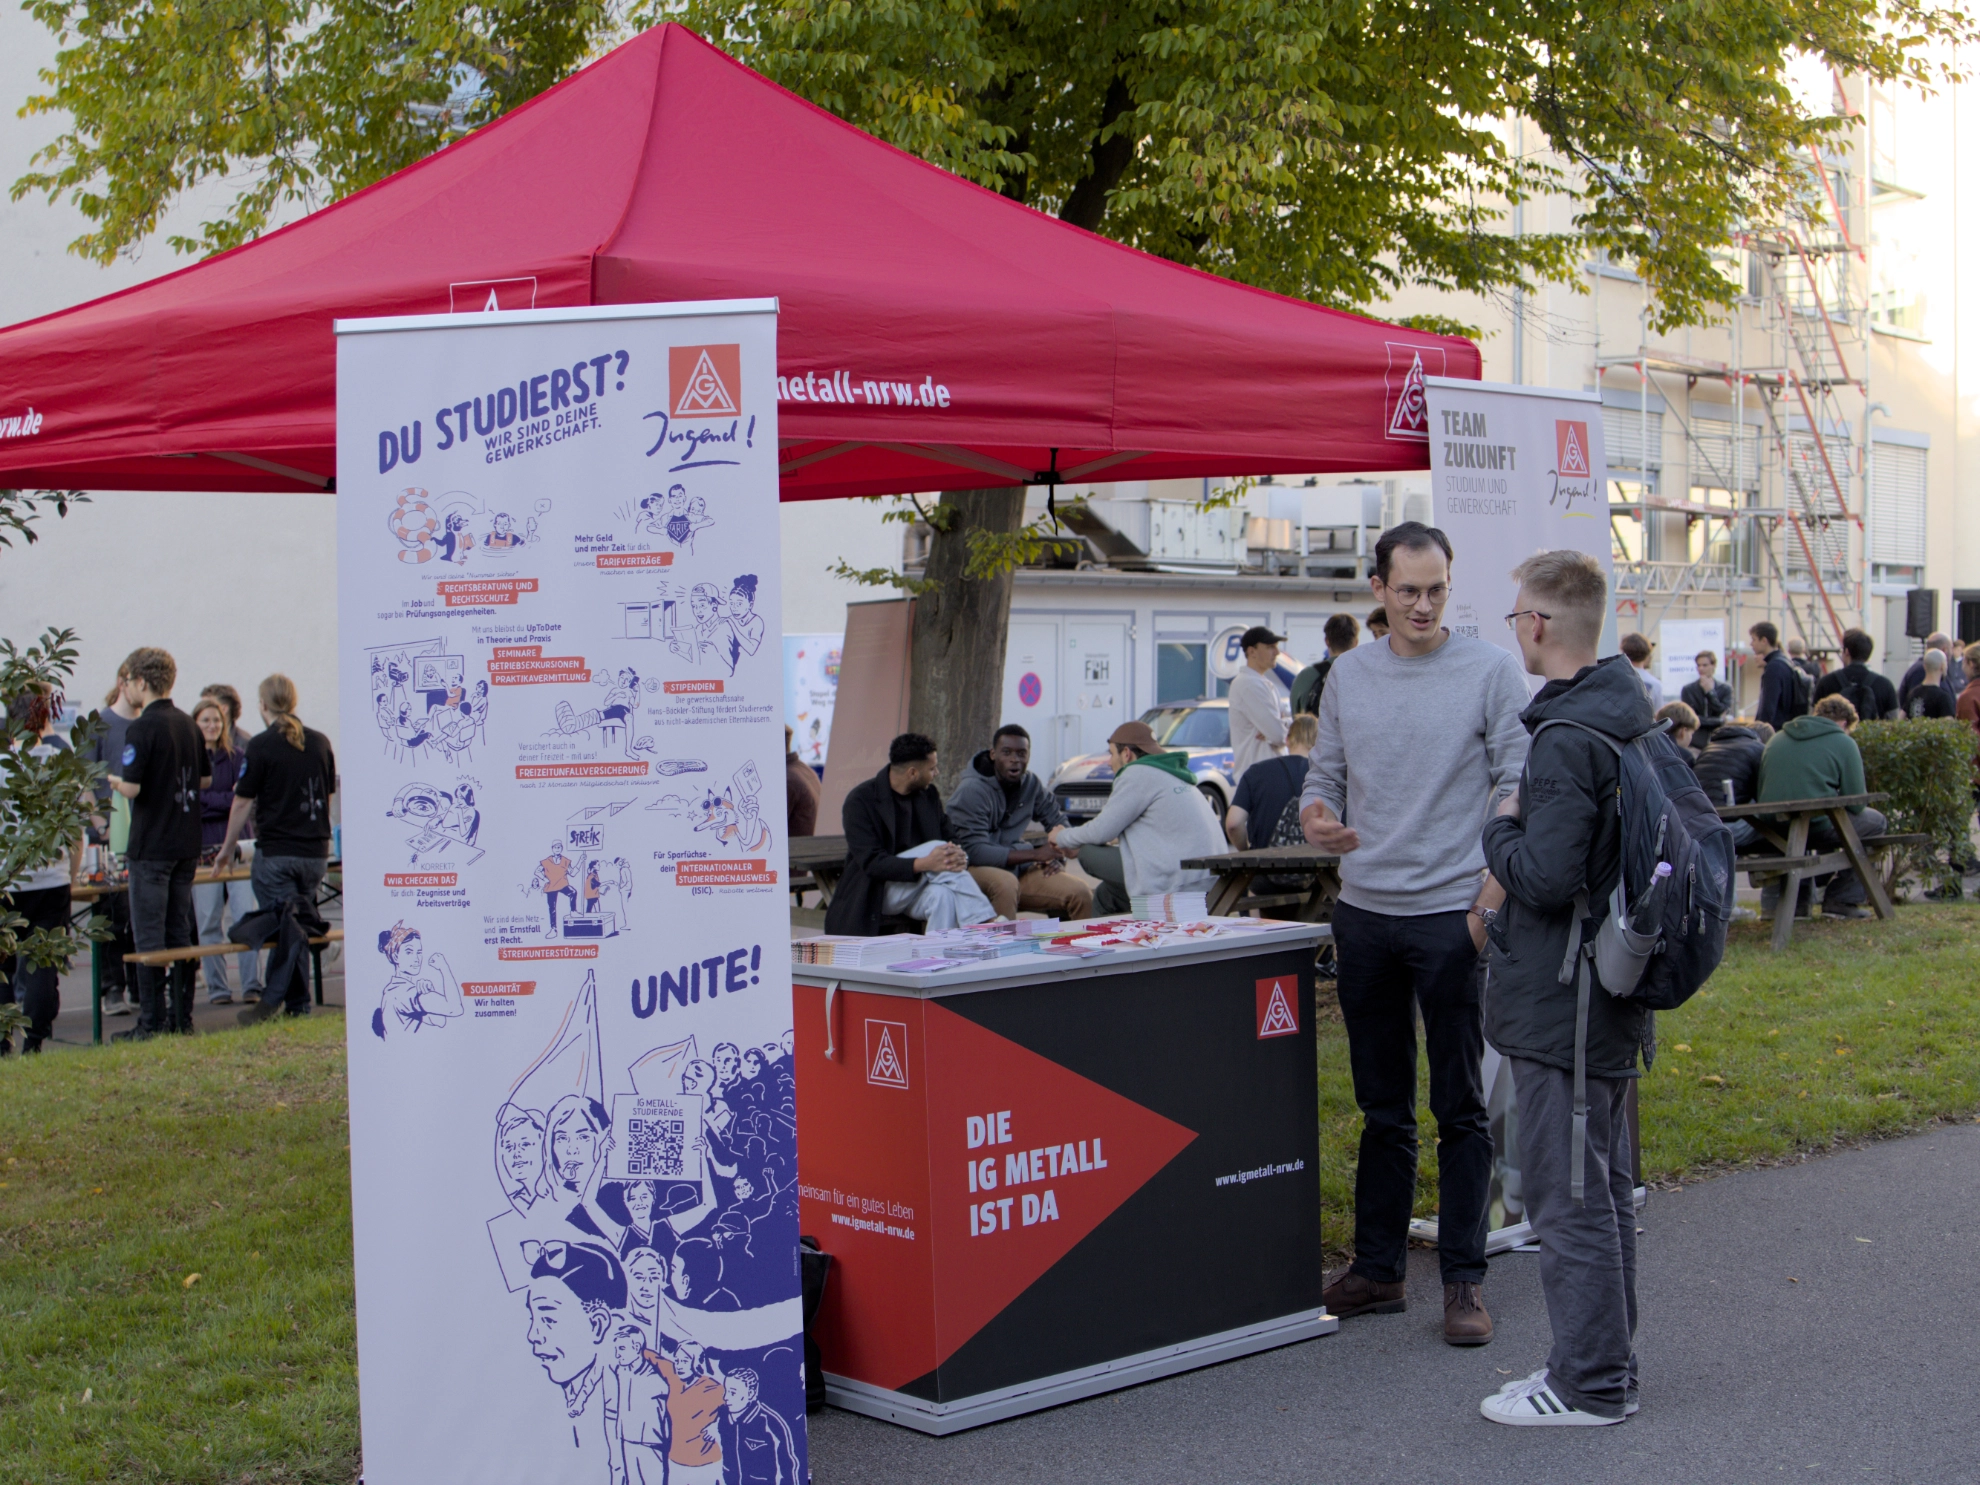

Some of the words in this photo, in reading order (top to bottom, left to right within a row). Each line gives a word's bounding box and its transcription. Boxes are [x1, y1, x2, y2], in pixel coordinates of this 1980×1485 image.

[378, 420, 422, 475] DU
[434, 349, 630, 452] STUDIERST?
[0, 406, 44, 439] rw.de
[484, 430, 514, 452] WIR
[517, 420, 551, 444] SIND
[555, 402, 599, 433] DEINE
[1441, 409, 1487, 438] TEAM
[485, 418, 602, 465] GEWERKSCHAFT.
[1443, 441, 1517, 471] ZUKUNFT
[1446, 475, 1487, 494] STUDIUM
[1488, 478, 1508, 496] UND
[1447, 497, 1518, 517] GEWERKSCHAFT
[574, 534, 594, 543] Mehr
[596, 534, 613, 542] Geld
[574, 545, 589, 553] und
[590, 544, 610, 552] mehr
[611, 544, 626, 552] Zeit
[627, 543, 636, 551] für
[599, 556, 661, 566] TARIFVERTRÄGE
[444, 581, 514, 593] RECHTSBERATUNG
[516, 582, 533, 590] UND
[410, 600, 423, 608] Job
[424, 598, 435, 607] und
[452, 594, 510, 604] RECHTSSCHUTZ
[406, 607, 497, 619] Prüfungsangelegenheiten.
[516, 624, 525, 632] du
[526, 623, 562, 634] UpToDate
[477, 636, 484, 644] in
[486, 635, 513, 644] Theorie
[514, 634, 528, 643] und
[529, 634, 552, 642] Praxis
[497, 648, 537, 658] SEMINARE
[490, 660, 580, 671] BETRIEBSEXKURSIONEN
[495, 672, 587, 684] PRAKTIKAVERMITTLUNG
[670, 682, 716, 692] STIPENDIEN
[654, 718, 665, 726] aus
[552, 741, 568, 750] auch
[520, 765, 646, 778] FREIZEITUNFALLVERSICHERUNG
[654, 850, 666, 860] Für
[667, 850, 707, 860] Sparfüchse
[420, 862, 456, 871] KORREKT?
[660, 864, 676, 873] dein
[680, 862, 753, 873] INTERNATIONALER
[387, 877, 404, 886] WIR
[404, 876, 439, 885] CHECKEN
[440, 876, 456, 884] DAS
[678, 874, 770, 884] STUDIERENDENAUSWEIS
[416, 888, 450, 899] Zeugnisse
[452, 888, 466, 896] und
[691, 886, 714, 896] (ISIC).
[416, 898, 471, 908] Arbeitsverträge
[498, 926, 508, 934] im
[510, 925, 541, 934] Ernstfall
[484, 936, 499, 945] erst
[500, 936, 524, 944] Recht.
[502, 946, 596, 959] STREIKUNTERSTÜTZUNG
[631, 944, 762, 1020] UNITE!
[470, 984, 522, 995] SOLIDARITÄT
[474, 998, 490, 1007] Wir
[490, 998, 515, 1007] halten
[474, 1008, 518, 1018] zusammen!
[637, 1098, 645, 1107] IG
[646, 1099, 678, 1108] METALL-
[632, 1108, 684, 1117] STUDIERENDE
[966, 1110, 1013, 1149] DIE
[968, 1156, 998, 1193] IG
[1004, 1138, 1108, 1188] METALL
[1215, 1158, 1305, 1188] www.igmetall-nrw.de
[833, 1188, 845, 1206] für
[846, 1192, 860, 1209] ein
[861, 1197, 886, 1215] gutes
[887, 1199, 914, 1220] Leben
[969, 1197, 1013, 1237] IST
[1022, 1189, 1060, 1228] DA
[831, 1212, 915, 1241] www.igmetall-nrw.de
